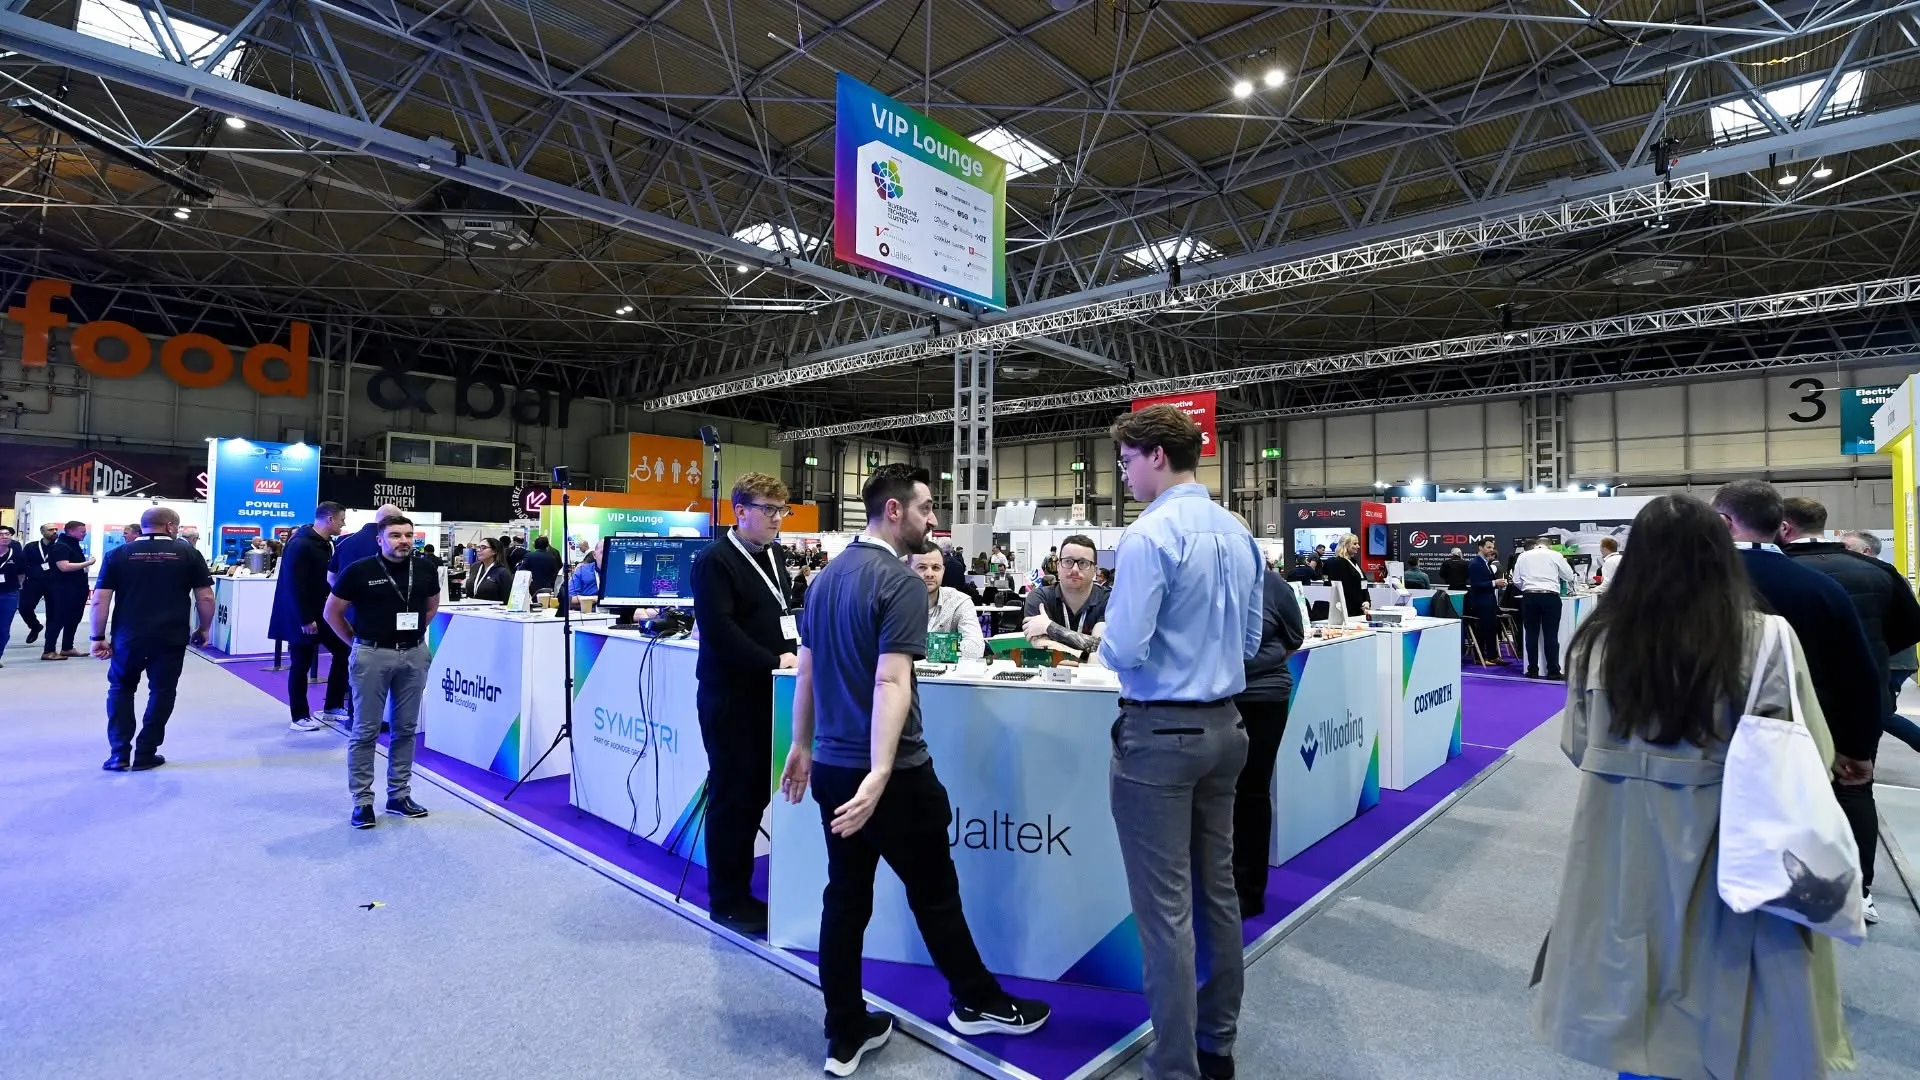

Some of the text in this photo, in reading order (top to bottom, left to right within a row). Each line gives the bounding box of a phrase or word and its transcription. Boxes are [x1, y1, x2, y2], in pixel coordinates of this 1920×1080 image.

[872, 102, 983, 177] VIP Lounge
[887, 201, 918, 218] SILVERSTONE
[887, 206, 920, 224] TECHNOLOGY
[887, 212, 908, 225] CLUSTER
[8, 278, 578, 429] food & bar
[1788, 378, 1827, 423] 3
[58, 459, 133, 496] THE EDGE
[256, 480, 281, 489] MW
[245, 500, 289, 509] POWER
[373, 495, 415, 508] KITCHEN
[511, 485, 523, 507] STREE
[238, 509, 295, 518] SUPPLIES
[607, 512, 664, 526] VIP Lounge
[1309, 509, 1346, 517] T3DMC
[454, 669, 502, 703] DaniHar
[454, 695, 478, 713] Technology
[1414, 683, 1453, 714] COSWORTH
[594, 706, 678, 754] SYMETRI
[1323, 708, 1364, 755] Wooding
[949, 807, 1072, 857] Jaltek
